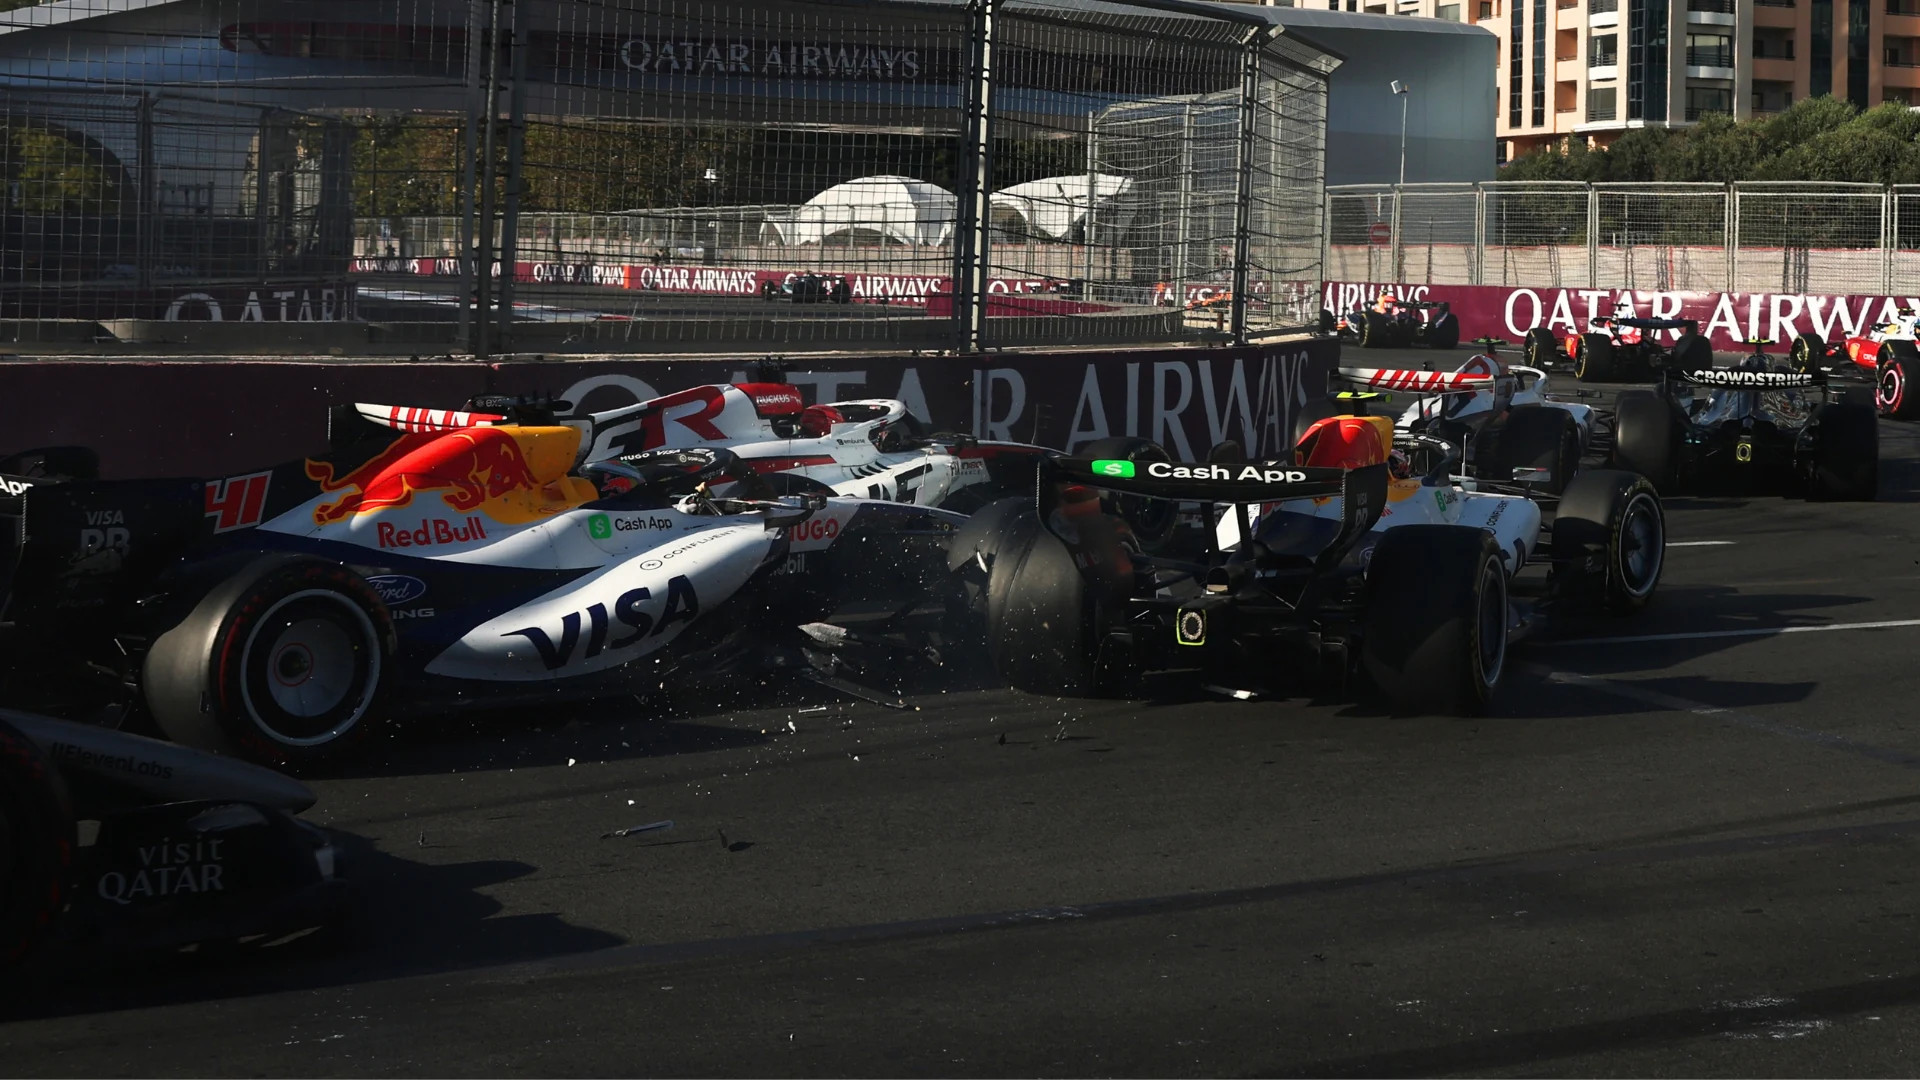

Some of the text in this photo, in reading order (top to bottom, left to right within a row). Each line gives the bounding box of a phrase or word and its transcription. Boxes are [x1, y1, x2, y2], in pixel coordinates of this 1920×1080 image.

[621, 39, 919, 79] QATAR AIRWAYS
[533, 264, 625, 286] QATAR AIRWAY
[640, 267, 690, 290] QATAR
[692, 270, 756, 294] AIRWAYS
[1504, 288, 1687, 342] QATAR
[1693, 369, 1813, 386] CROWDSTRIKE
[756, 394, 791, 404] RUCKUS
[620, 453, 650, 461] HUGO
[1148, 463, 1307, 484] Cash App
[205, 470, 274, 535] 41
[86, 510, 125, 526] VISA
[615, 518, 646, 531] Cash
[649, 516, 673, 531] App
[377, 516, 488, 549] Red Bull
[663, 529, 737, 560] CONFLUENT
[500, 574, 699, 670] VISA
[139, 836, 225, 865] visit
[97, 863, 225, 905] QATAR
